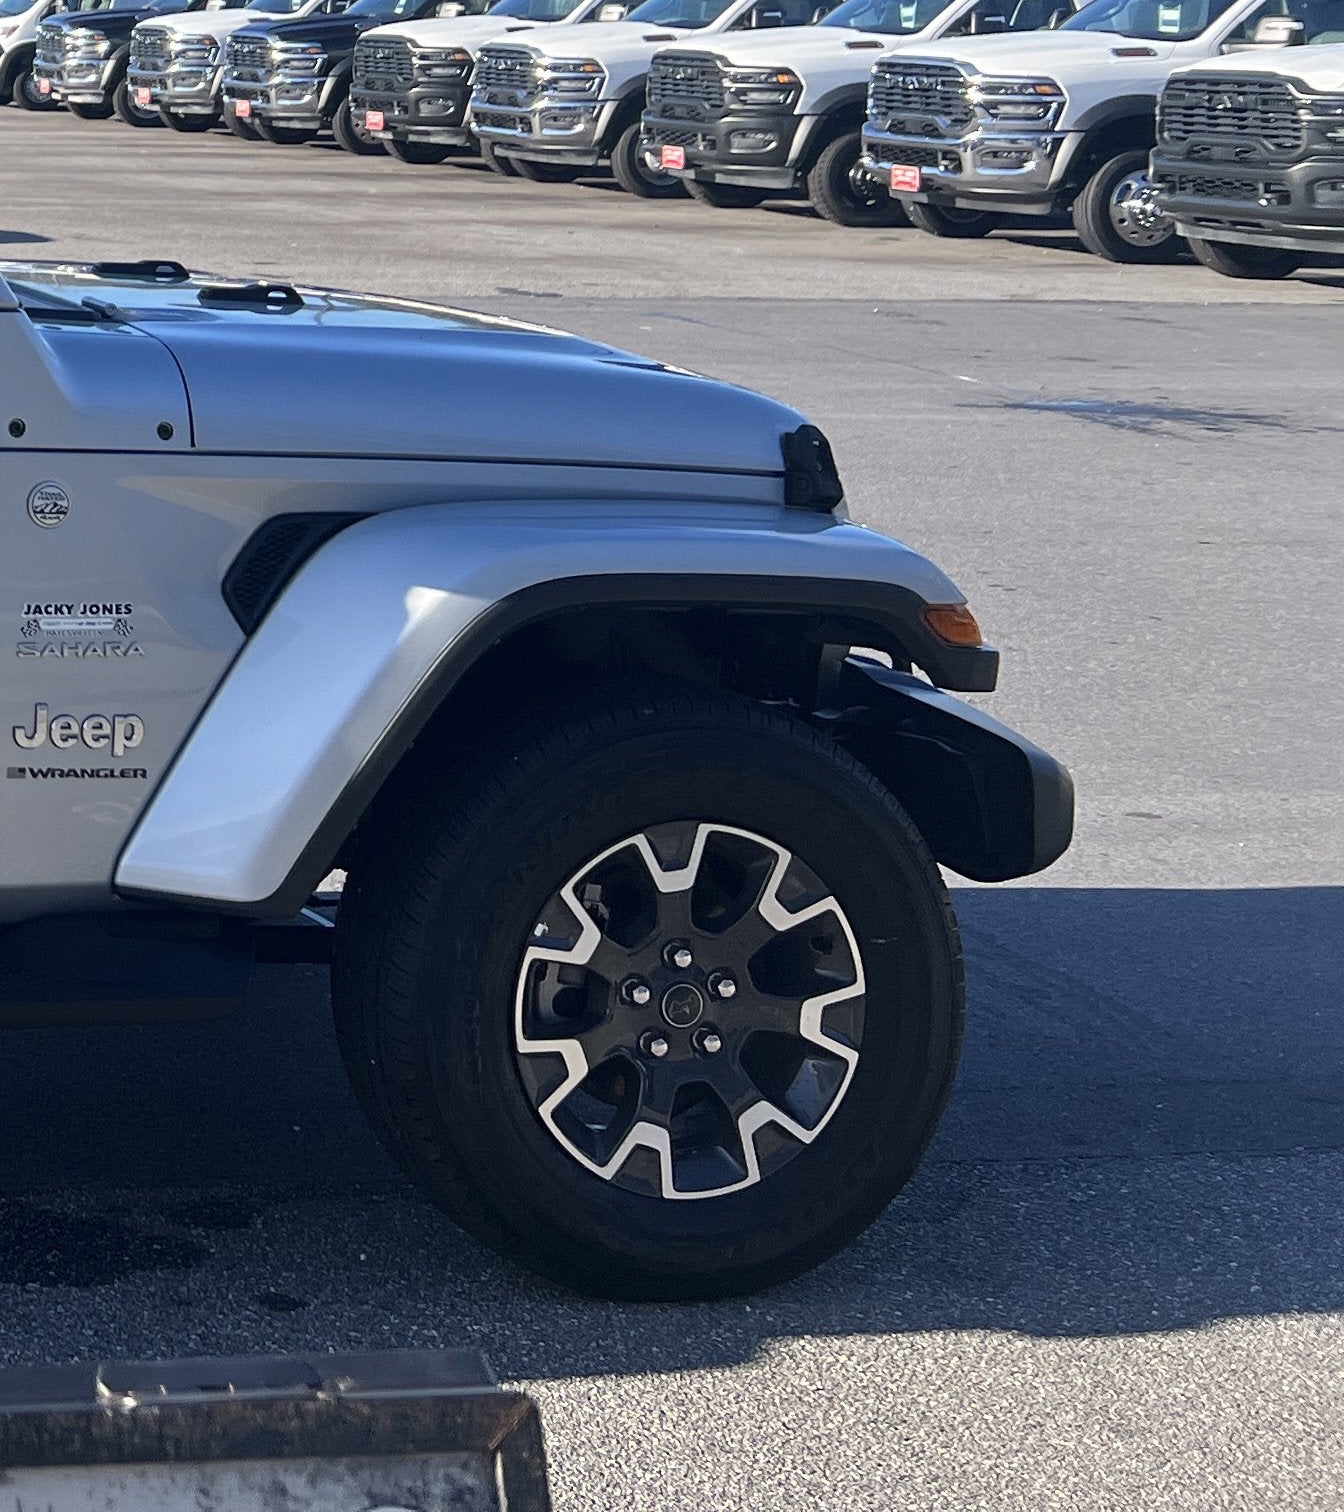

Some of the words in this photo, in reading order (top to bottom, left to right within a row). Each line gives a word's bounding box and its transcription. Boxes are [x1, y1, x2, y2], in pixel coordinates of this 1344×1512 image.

[23, 603, 74, 616] JACKY
[79, 603, 133, 616] JONES
[16, 641, 146, 658] SAHARA
[12, 702, 145, 758] Jeep
[28, 767, 148, 779] WRANGLER
